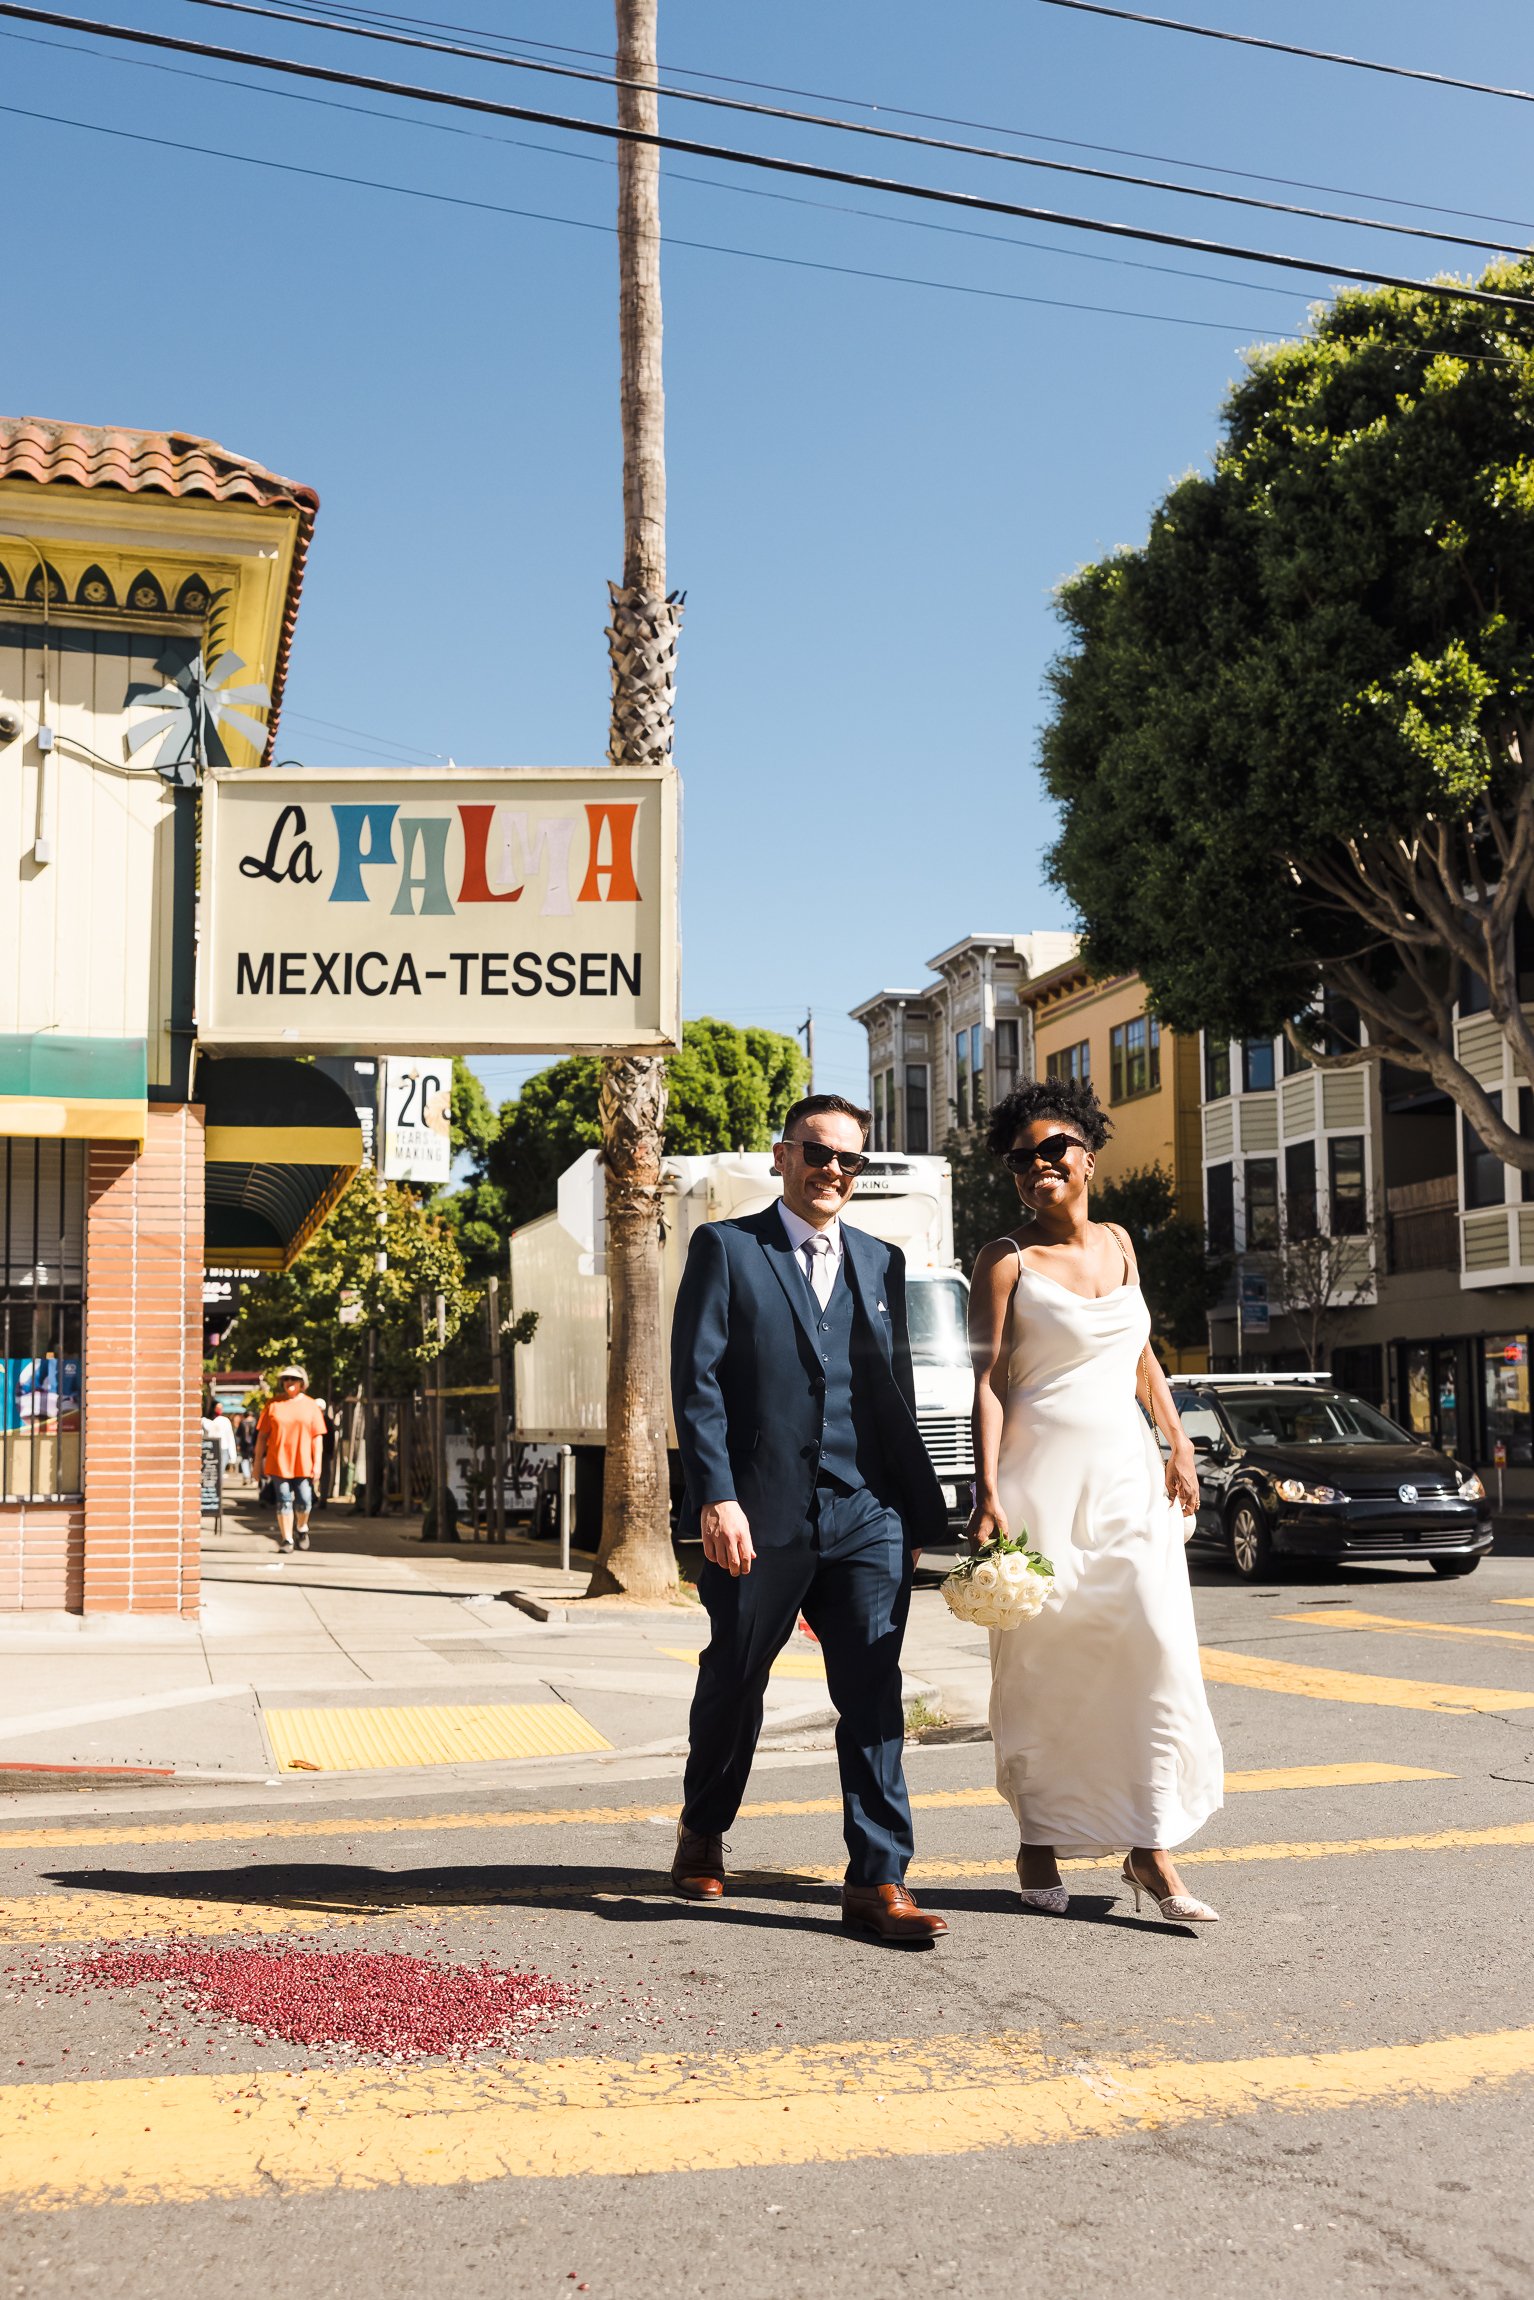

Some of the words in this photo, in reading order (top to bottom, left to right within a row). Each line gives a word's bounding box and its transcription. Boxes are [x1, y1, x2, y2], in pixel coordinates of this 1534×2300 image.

[238, 805, 322, 884] La
[328, 804, 643, 916] PALMA
[236, 952, 642, 997] MEXICA-TESSEN
[395, 1131, 430, 1145] YEARS
[394, 1146, 442, 1162] MAKING
[861, 1181, 889, 1189] KING
